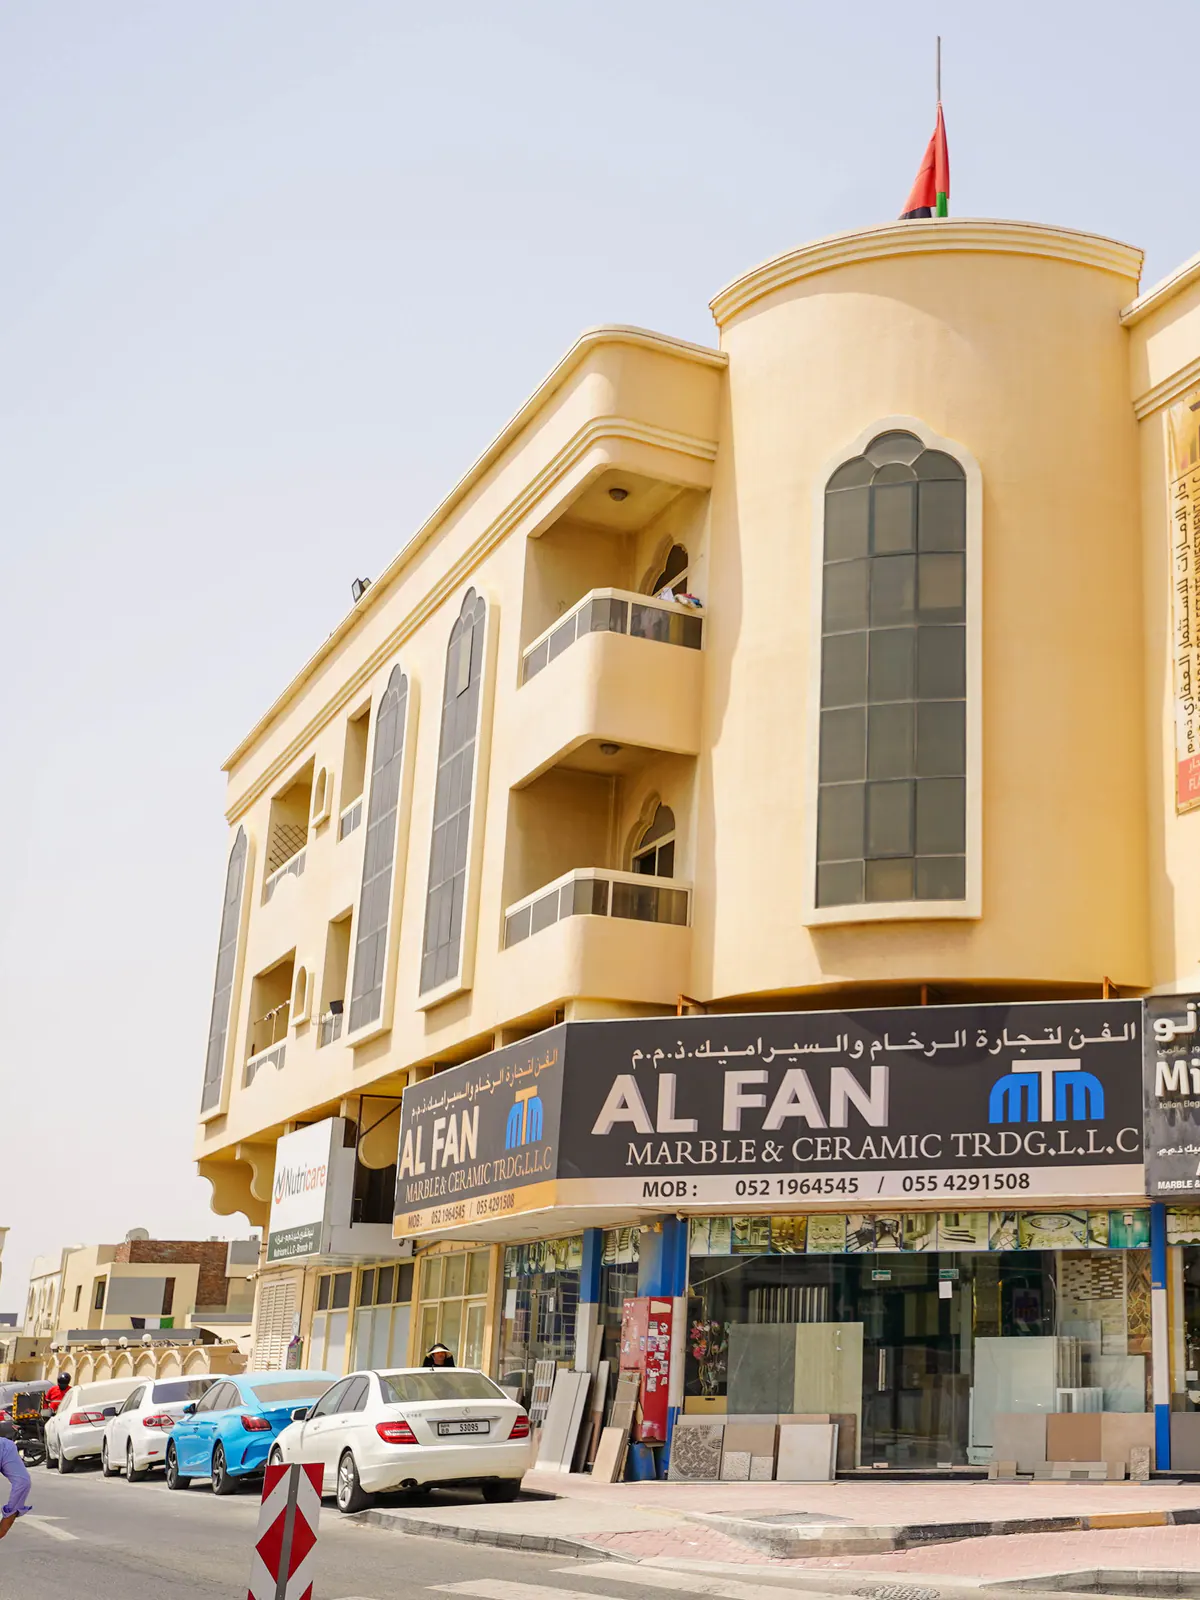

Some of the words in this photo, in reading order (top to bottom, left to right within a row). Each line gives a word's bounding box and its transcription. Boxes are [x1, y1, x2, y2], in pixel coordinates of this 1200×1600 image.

[1175, 482, 1189, 501] دار
[870, 1029, 967, 1061] الرخام
[976, 1026, 1062, 1055] لتجارة
[1068, 1021, 1136, 1050] الفن
[506, 1057, 534, 1087] لتجارة
[534, 1048, 558, 1078] الفن
[474, 1069, 504, 1099] الرخام
[591, 1073, 698, 1135] AL
[722, 1065, 889, 1131] FAN
[398, 1125, 426, 1180] AL
[431, 1105, 480, 1171] FAN
[626, 1139, 757, 1166] MARBLE
[761, 1140, 784, 1162] &
[792, 1133, 942, 1163] CERAMIC
[285, 1162, 326, 1198] Nutricare
[405, 1178, 440, 1204] MARBLE
[440, 1176, 448, 1196] &
[448, 1162, 491, 1194] CERAMIC
[735, 1179, 770, 1196] 052
[776, 1177, 859, 1195] 1964545
[902, 1175, 938, 1192] 055
[944, 1173, 1030, 1190] 4291508
[1157, 1180, 1193, 1190] MARBLE
[1194, 1180, 1200, 1188] &
[431, 1210, 441, 1225] 052
[442, 1205, 465, 1222] 1964545
[476, 1200, 488, 1215] 055
[488, 1193, 515, 1213] 4291508
[459, 1422, 479, 1432] 53095
